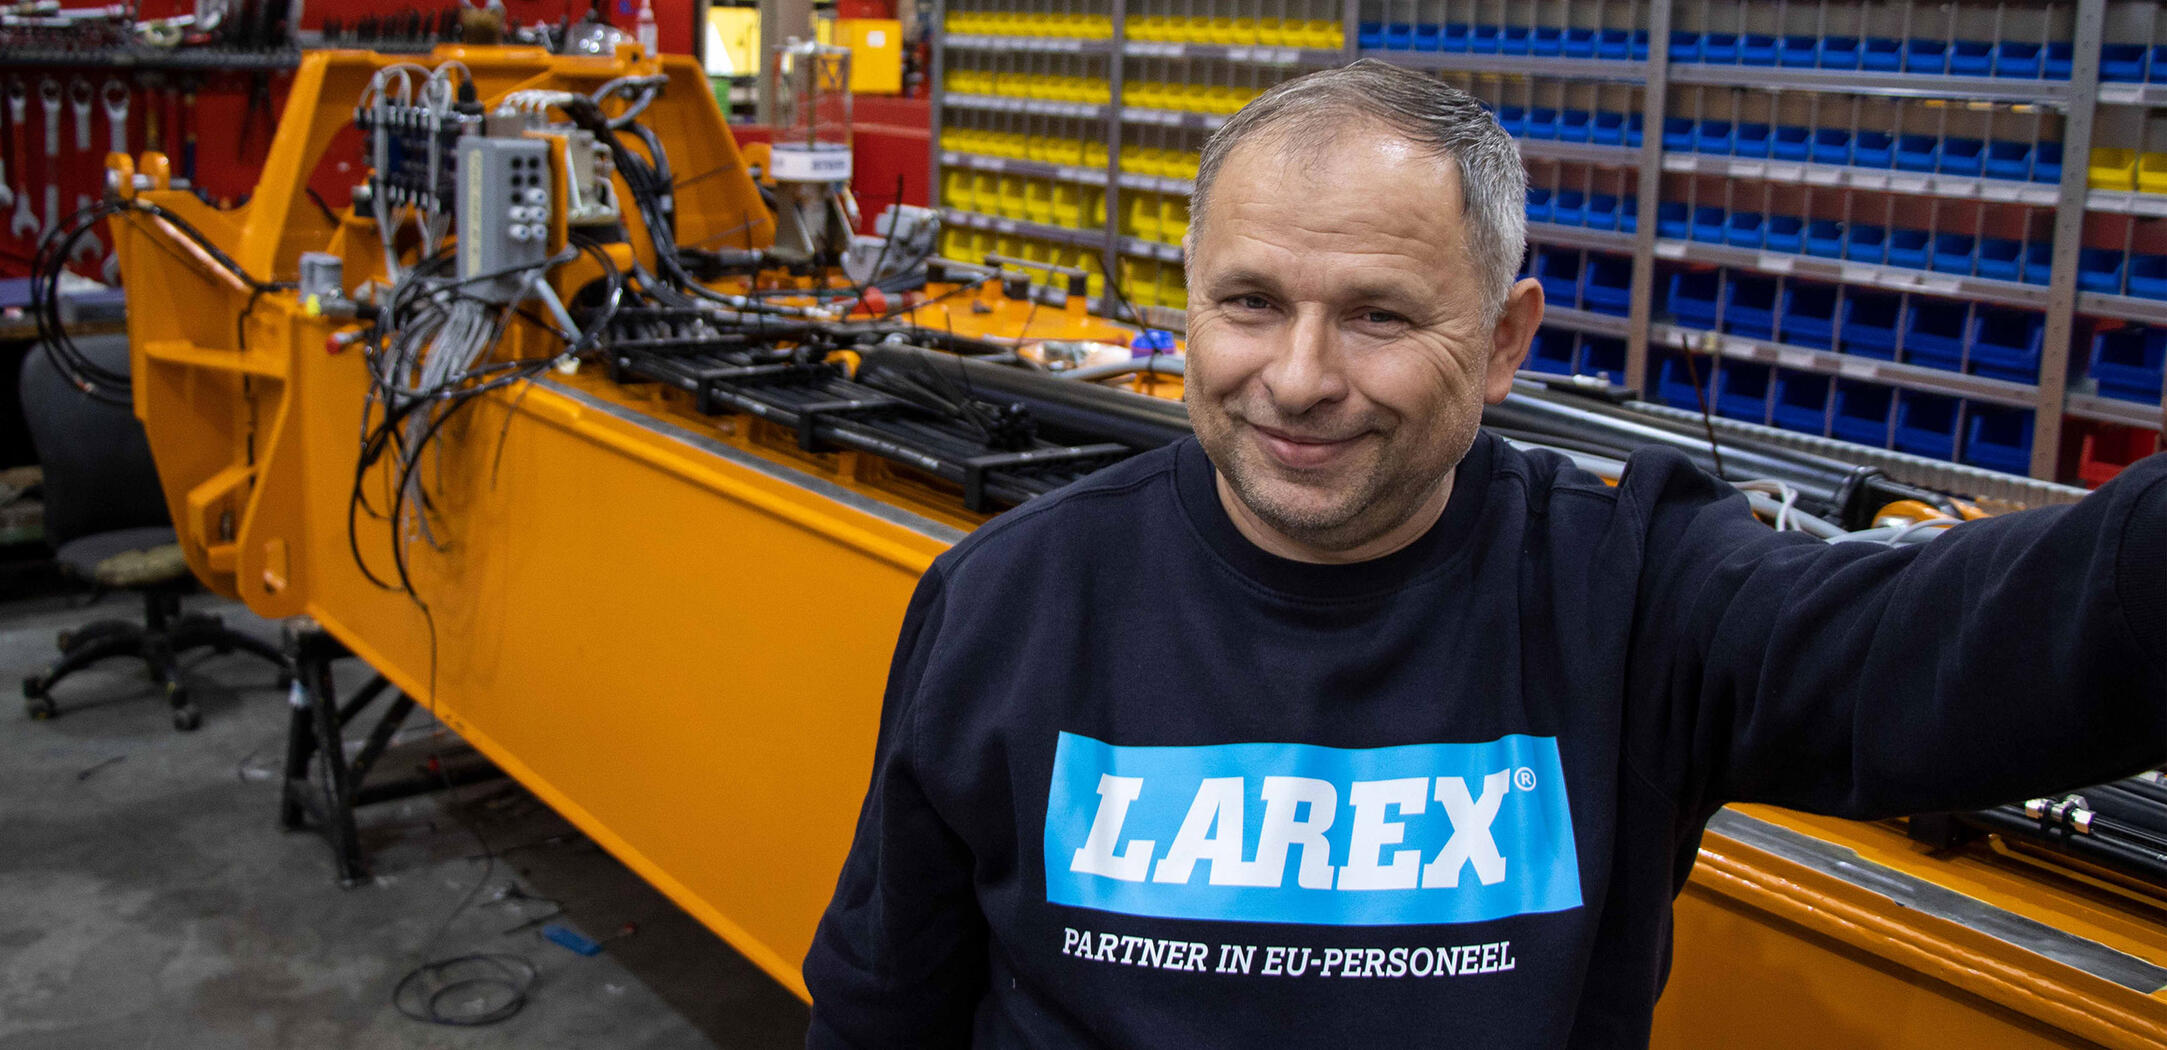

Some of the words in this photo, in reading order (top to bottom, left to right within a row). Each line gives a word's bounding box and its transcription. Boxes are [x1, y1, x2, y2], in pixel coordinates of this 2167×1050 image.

[1062, 927, 1209, 972] PARTNER
[1215, 944, 1258, 974] IN
[1260, 940, 1516, 977] EU-PERSONEEL
